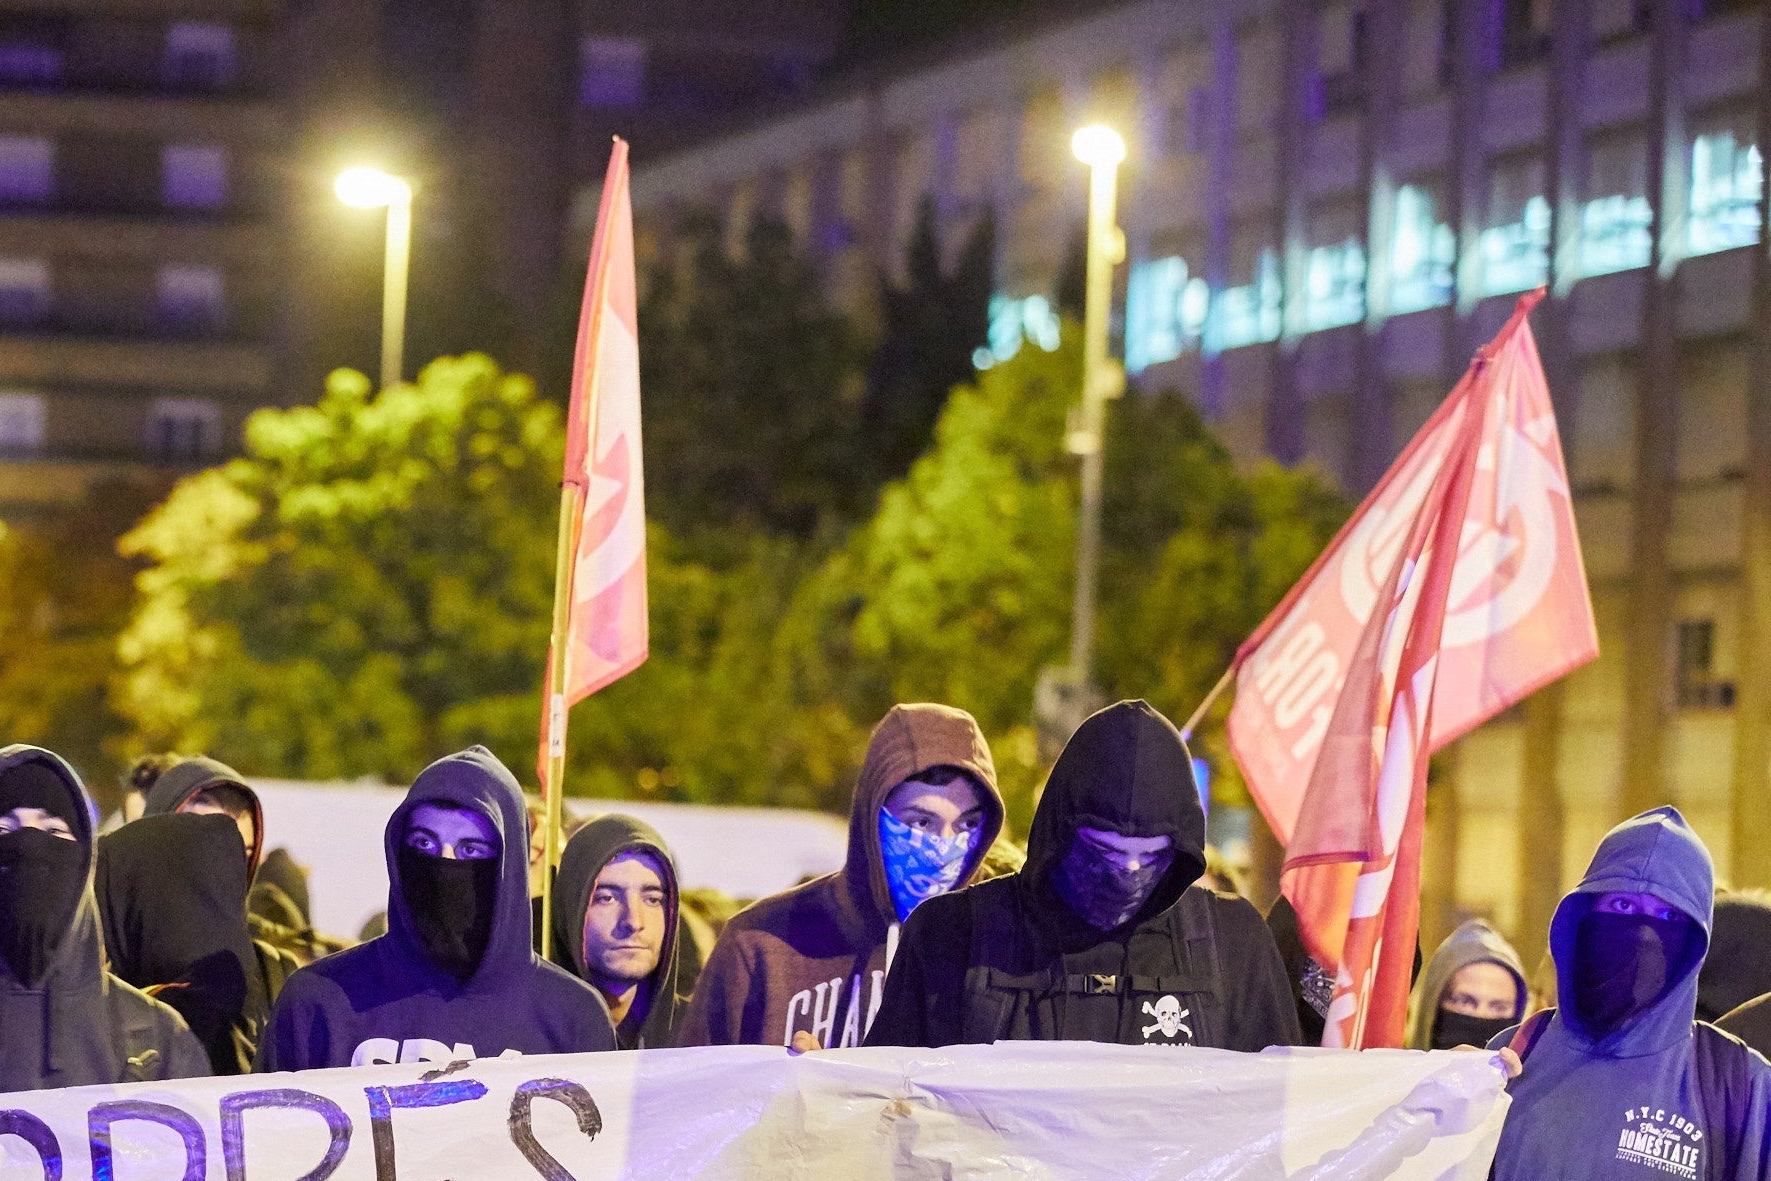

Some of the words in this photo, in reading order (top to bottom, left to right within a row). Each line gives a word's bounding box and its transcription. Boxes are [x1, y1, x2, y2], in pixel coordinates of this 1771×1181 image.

[1625, 1106, 1665, 1122] N.Y.C
[1669, 1114, 1703, 1142] 1903
[1619, 1129, 1699, 1168] HOMESTATE
